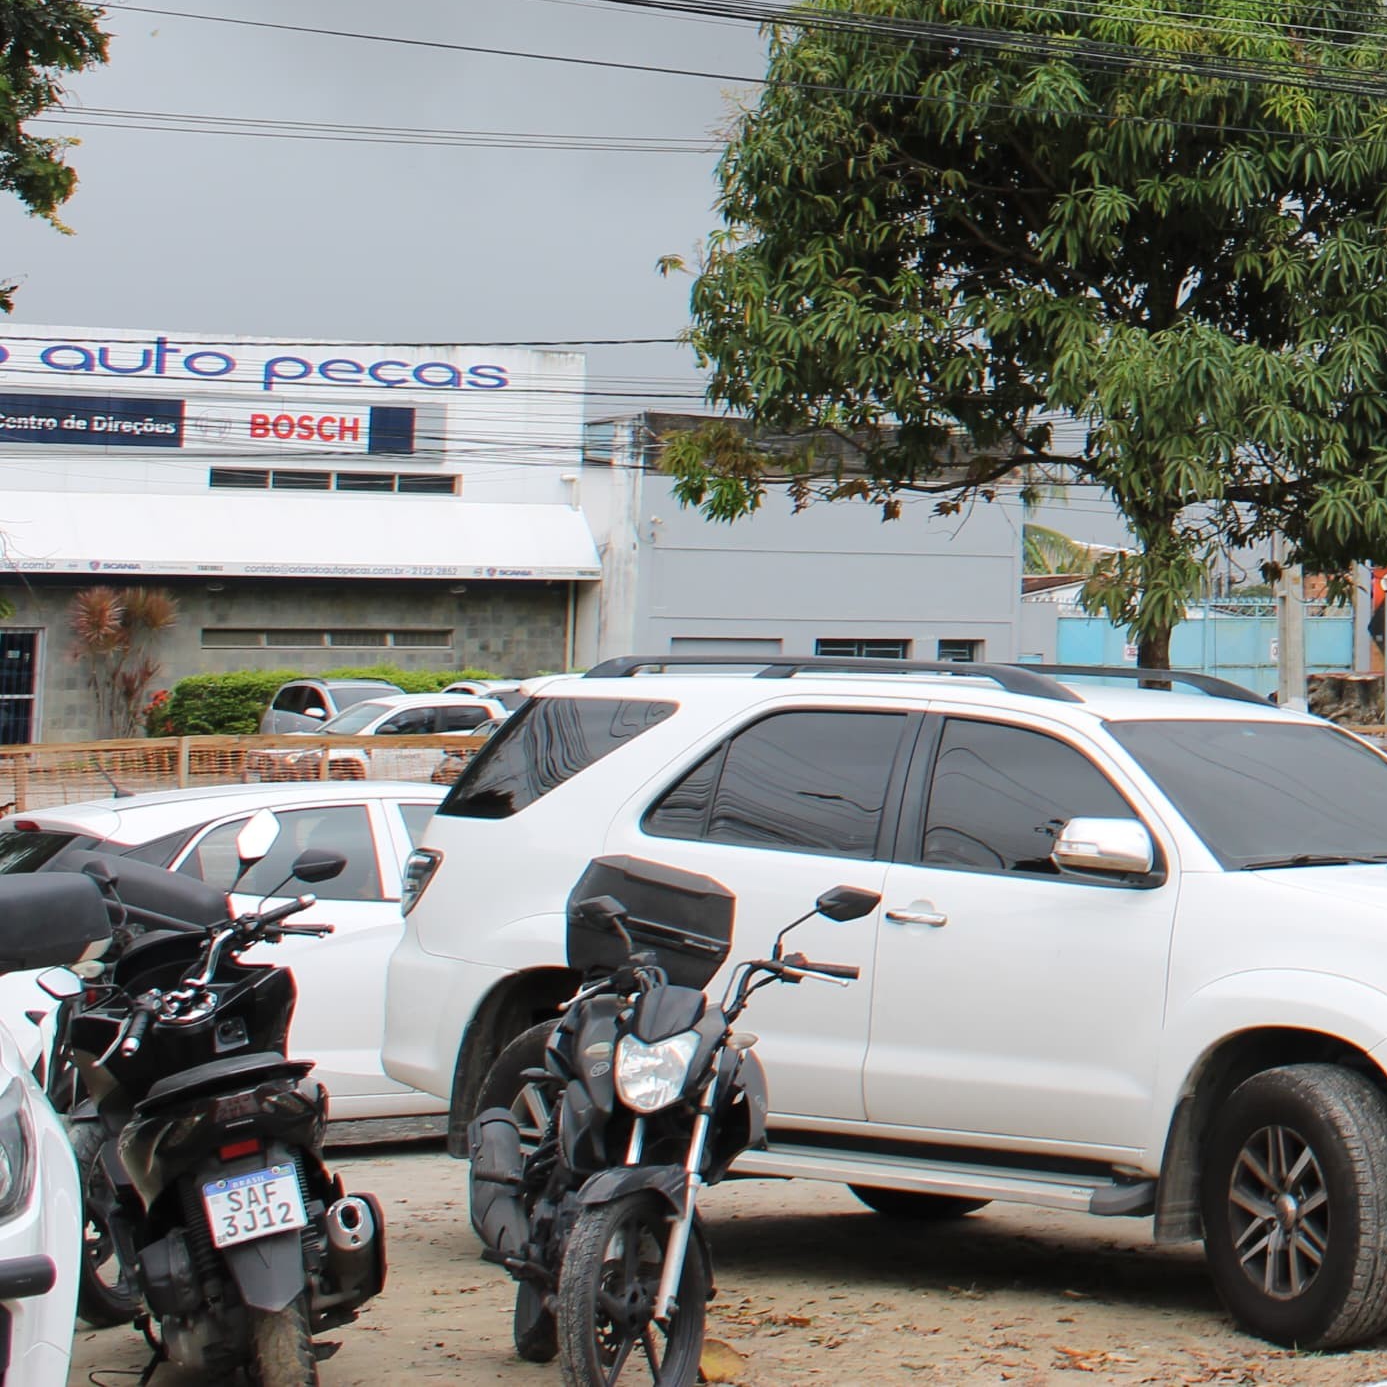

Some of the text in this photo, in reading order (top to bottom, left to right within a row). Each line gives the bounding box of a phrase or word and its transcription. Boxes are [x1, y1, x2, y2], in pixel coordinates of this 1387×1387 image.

[40, 337, 237, 376] auto
[263, 356, 509, 391] peças
[62, 414, 87, 431] de
[91, 416, 176, 435] Direções
[249, 413, 360, 442] BOSCH
[227, 1180, 277, 1213] SAF
[231, 1175, 265, 1189] BRASIL
[222, 1202, 295, 1238] 3J12
